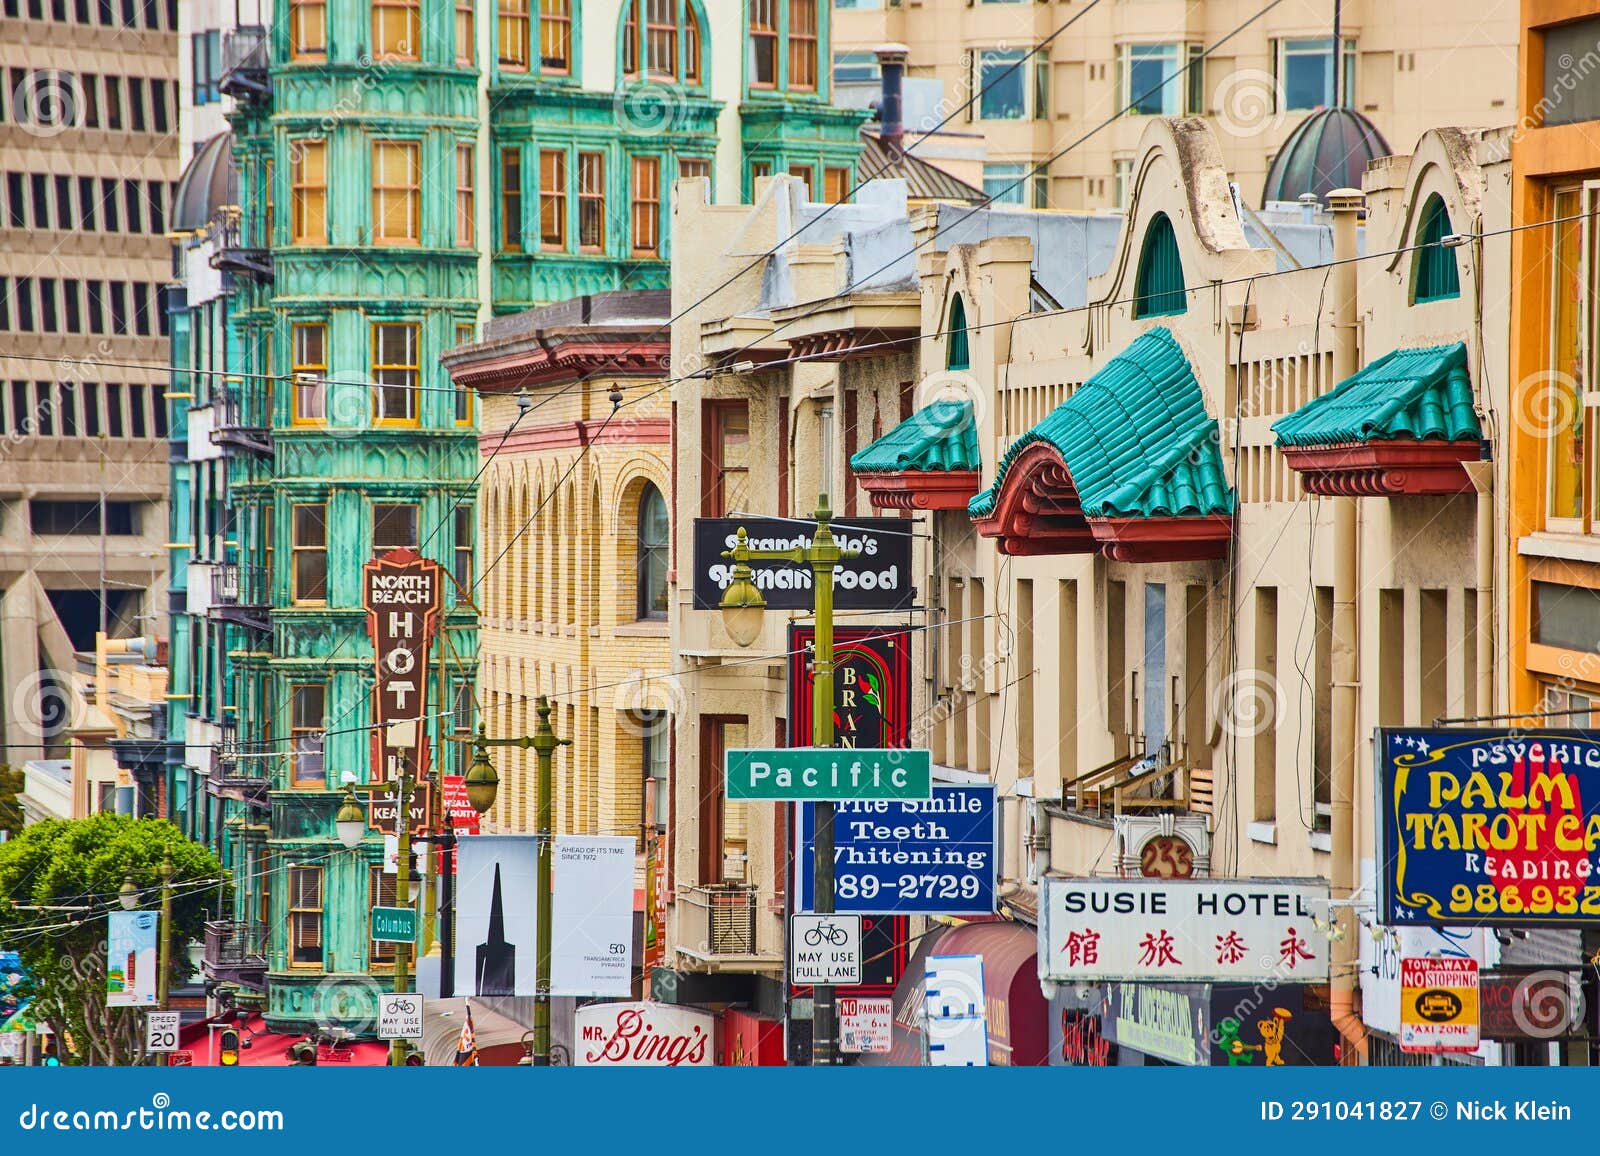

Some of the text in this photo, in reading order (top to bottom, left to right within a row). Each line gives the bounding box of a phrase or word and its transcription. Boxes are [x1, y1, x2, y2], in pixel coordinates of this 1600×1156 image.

[725, 534, 812, 551] rand
[371, 575, 430, 589] NORTH
[708, 564, 898, 591] Hnan Food
[371, 590, 430, 604] BEACH
[386, 612, 416, 781] HOTL
[1472, 743, 1600, 767] PSYCHIC
[750, 762, 907, 787] Pacific
[1428, 771, 1576, 809] PALM
[834, 793, 982, 813] rite Smile
[373, 808, 425, 819] KEANY
[444, 809, 478, 818] QUITY
[850, 822, 950, 840] Teeth
[1405, 813, 1547, 851] TAROT
[1465, 853, 1600, 880] READING
[834, 874, 980, 899] 89-2729
[1065, 892, 1309, 917] SUSIE HOTEL
[1449, 884, 1600, 915] 986.932
[376, 915, 411, 934] Columbus
[798, 952, 855, 963] MAY USE
[796, 967, 857, 977] FULL LANE
[1403, 972, 1477, 988] NO STOPPING
[842, 1001, 890, 1015] NO PARKING
[381, 1027, 399, 1035] FULL
[583, 1026, 608, 1042] MR.
[585, 1009, 708, 1066] Bing's
[1411, 1025, 1469, 1035] TAXI ZONE
[151, 1033, 175, 1048] 20
